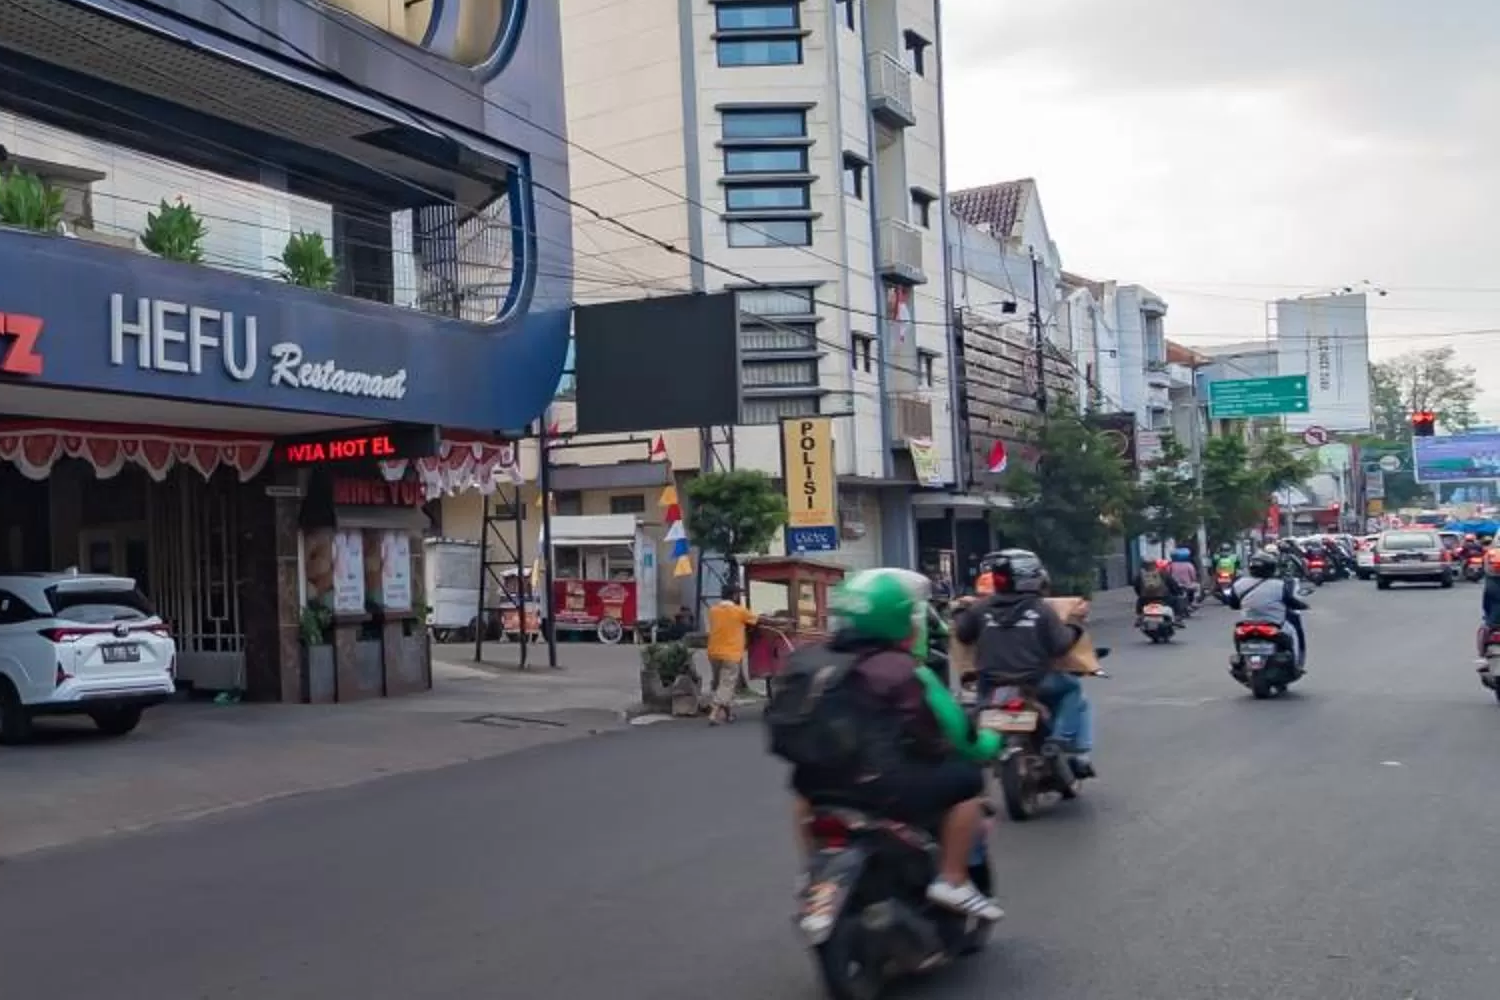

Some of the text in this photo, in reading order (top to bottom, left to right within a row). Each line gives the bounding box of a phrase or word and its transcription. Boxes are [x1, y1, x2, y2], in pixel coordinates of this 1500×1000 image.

[110, 293, 407, 399] HEFU Restaurant
[800, 421, 817, 510] POLISI
